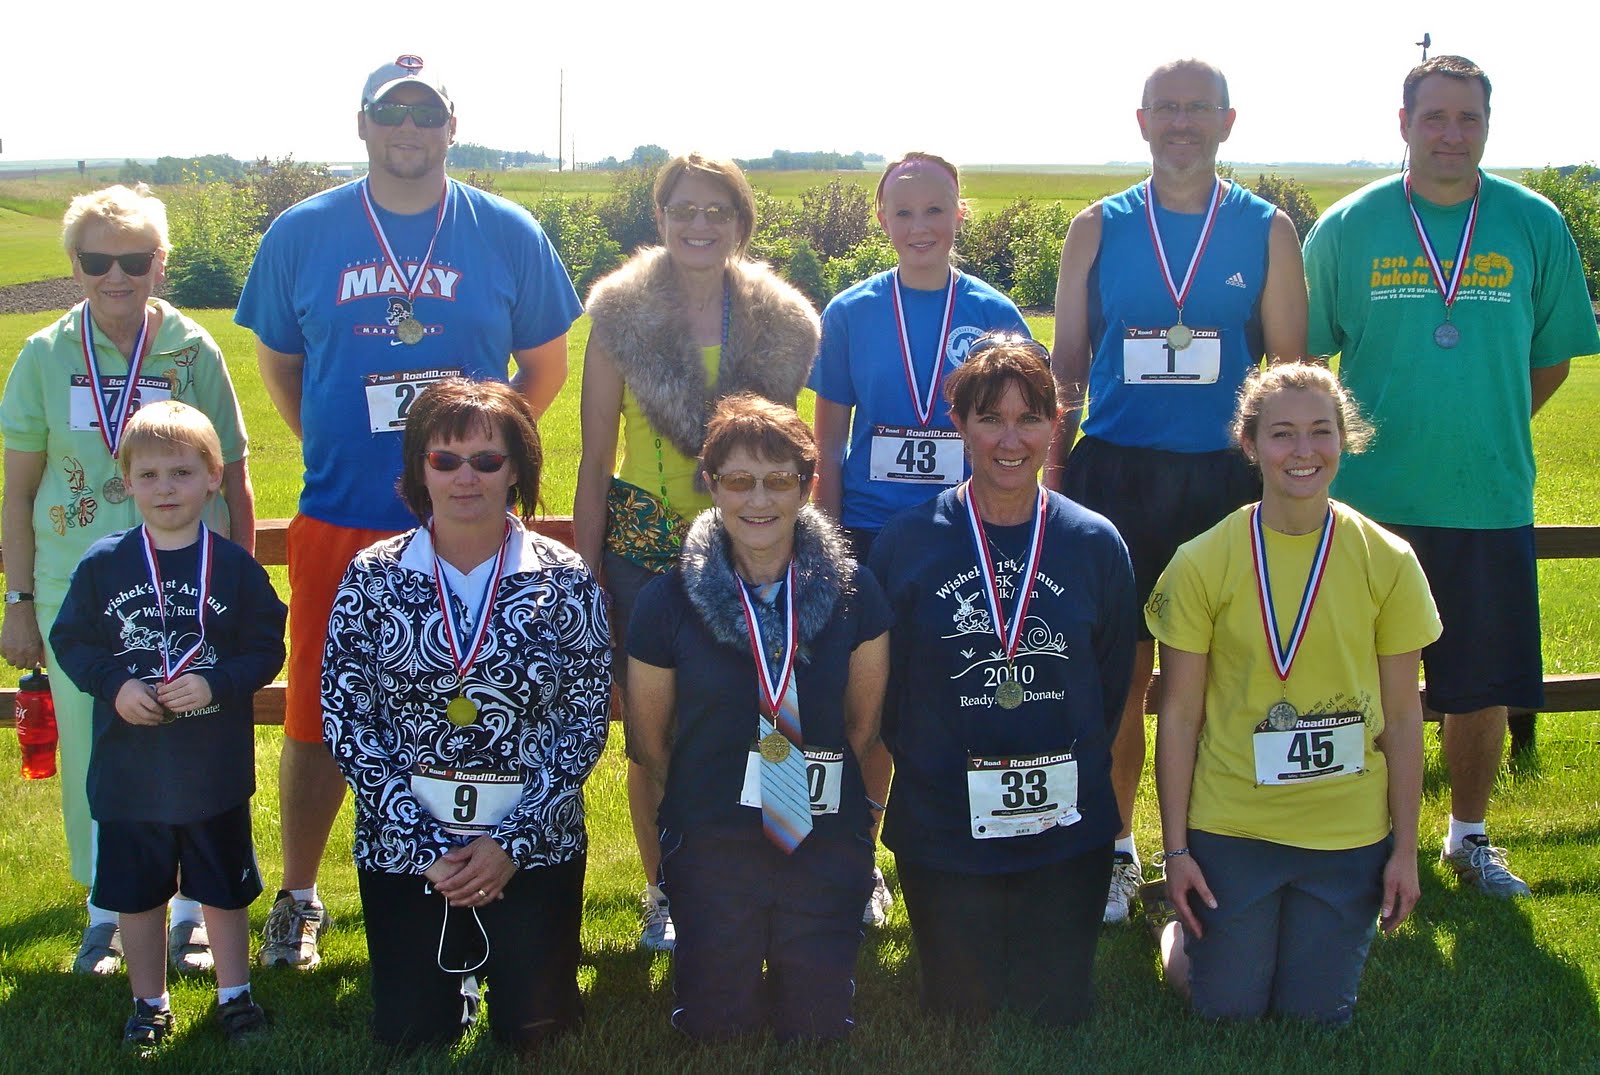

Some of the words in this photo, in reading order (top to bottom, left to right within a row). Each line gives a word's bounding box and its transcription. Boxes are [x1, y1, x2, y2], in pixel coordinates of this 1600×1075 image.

[340, 264, 459, 301] MARY
[1370, 268, 1429, 288] Dakota
[362, 327, 436, 336] MARARS
[1159, 329, 1218, 338] R.com
[402, 369, 461, 381] RoadID.com
[896, 440, 936, 474] 43
[178, 583, 228, 616] Anual
[984, 665, 1035, 688] 2010
[1023, 690, 1065, 703] Donate!
[184, 703, 221, 719] Donate!
[1295, 715, 1362, 729] RoadID.com
[1287, 730, 1335, 770] 45
[1009, 753, 1072, 768] RoadID.com
[454, 771, 520, 783] RoadID.com
[1001, 769, 1048, 808] 33
[453, 784, 478, 823] 9
